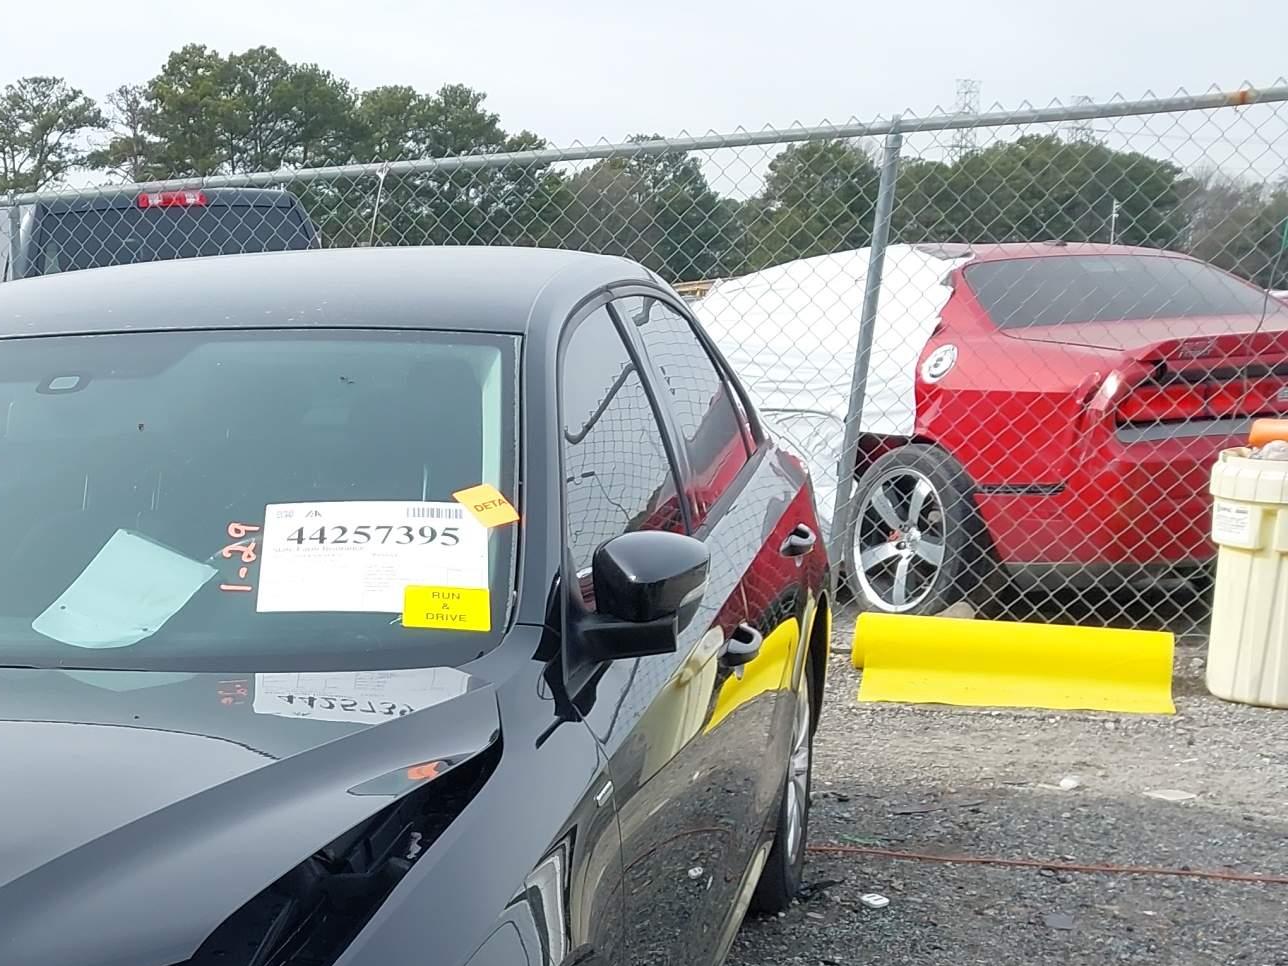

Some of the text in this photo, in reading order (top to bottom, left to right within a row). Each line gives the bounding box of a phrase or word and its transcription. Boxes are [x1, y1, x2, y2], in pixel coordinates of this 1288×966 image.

[286, 525, 460, 546] 44257395
[220, 522, 260, 592] 1-29
[431, 591, 461, 600] RUN
[441, 602, 450, 610] &
[425, 612, 467, 622] DRIVE
